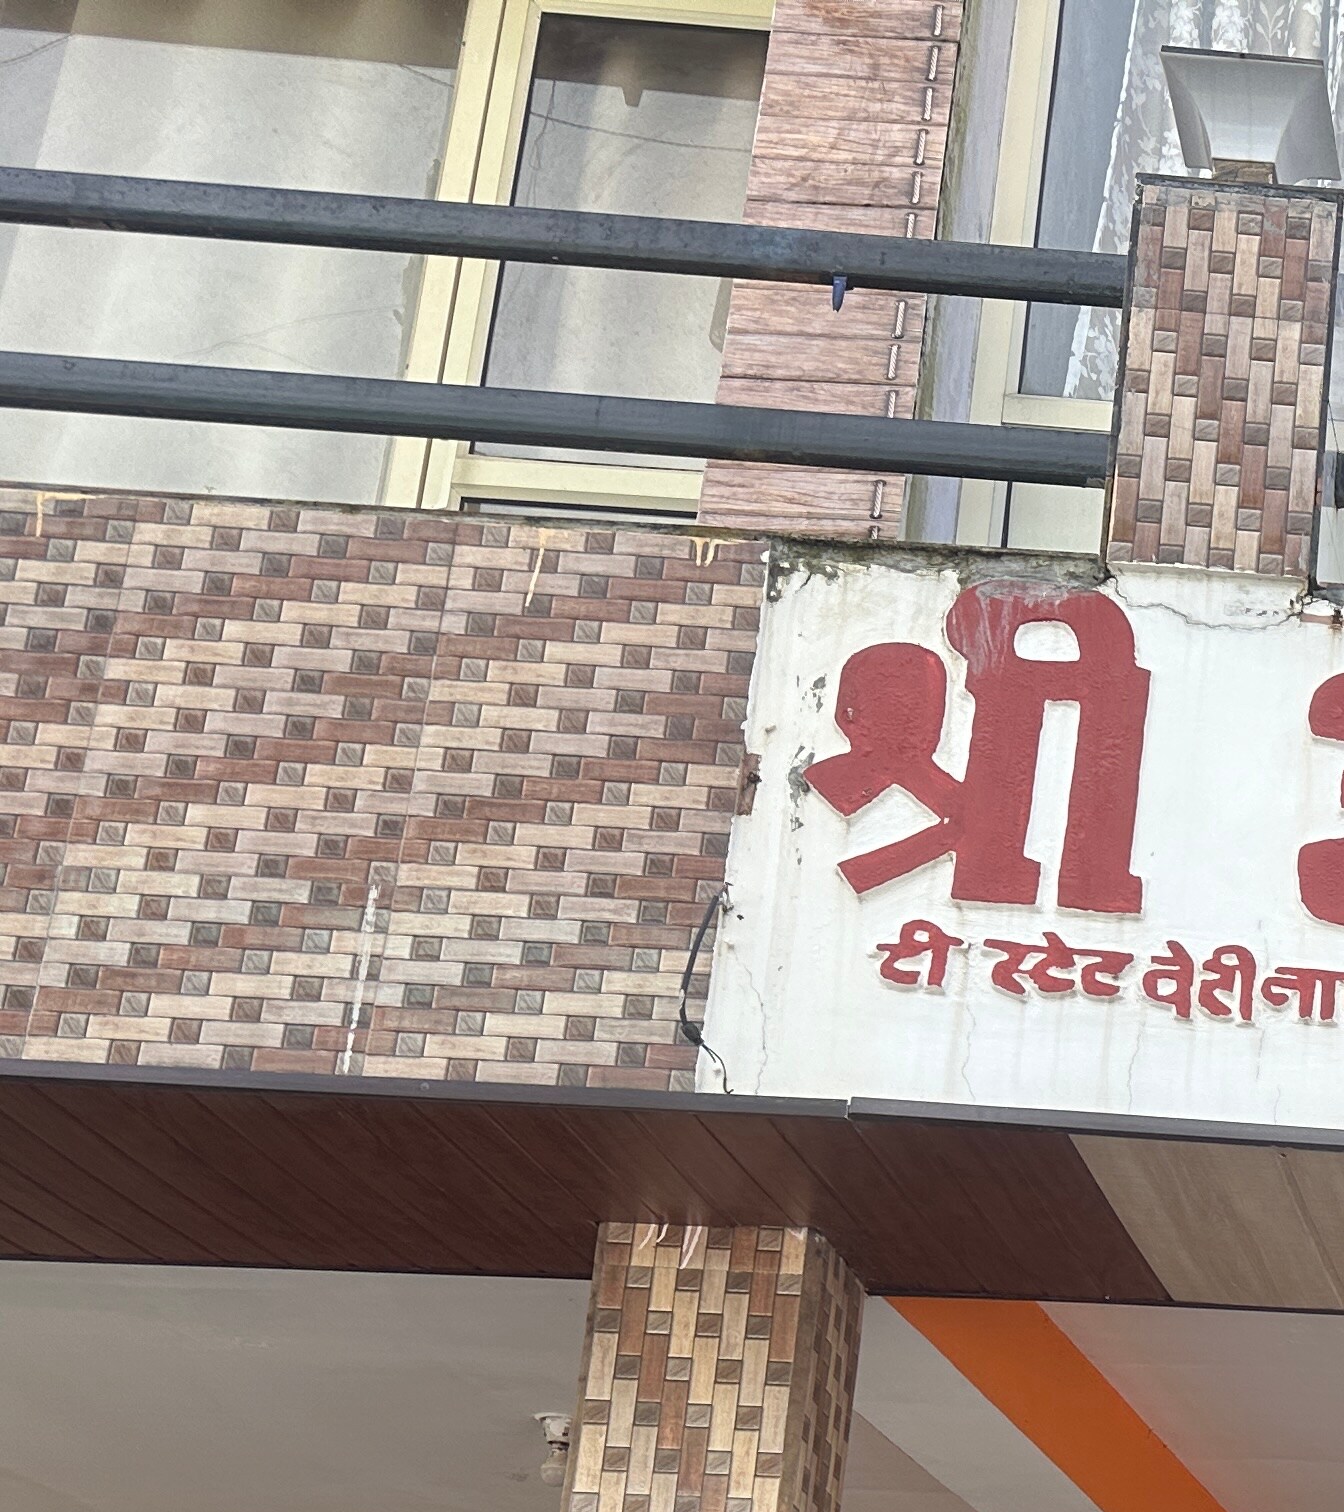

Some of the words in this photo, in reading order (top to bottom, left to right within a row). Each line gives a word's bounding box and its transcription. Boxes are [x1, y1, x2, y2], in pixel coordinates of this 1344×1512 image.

[804, 582, 1152, 914] श्री
[876, 919, 965, 988] टी
[983, 931, 1134, 997] स्टेट
